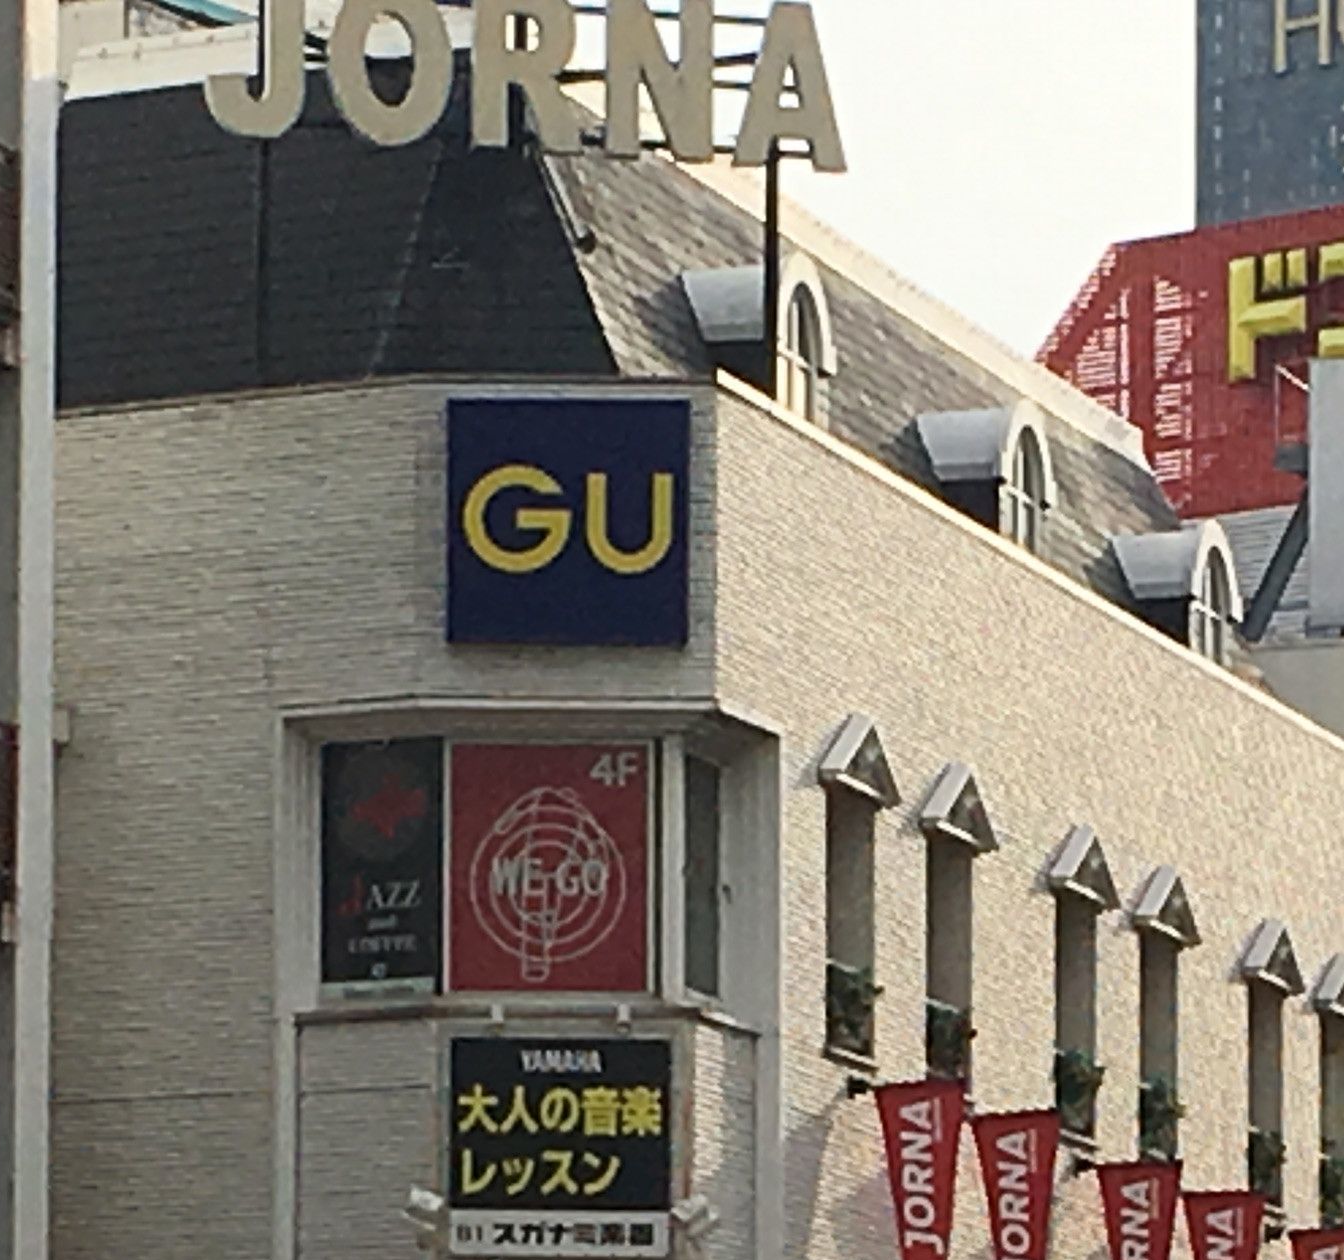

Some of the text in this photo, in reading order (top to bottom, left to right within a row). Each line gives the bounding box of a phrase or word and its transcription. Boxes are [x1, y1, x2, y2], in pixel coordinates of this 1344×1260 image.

[202, 0, 848, 173] JORNA
[463, 464, 674, 576] GU
[589, 751, 641, 787] 4F
[520, 1050, 602, 1073] YAMAHA
[458, 1083, 662, 1137] 大人の音楽
[460, 1147, 621, 1197] レッスン
[899, 1099, 945, 1256] JORNA
